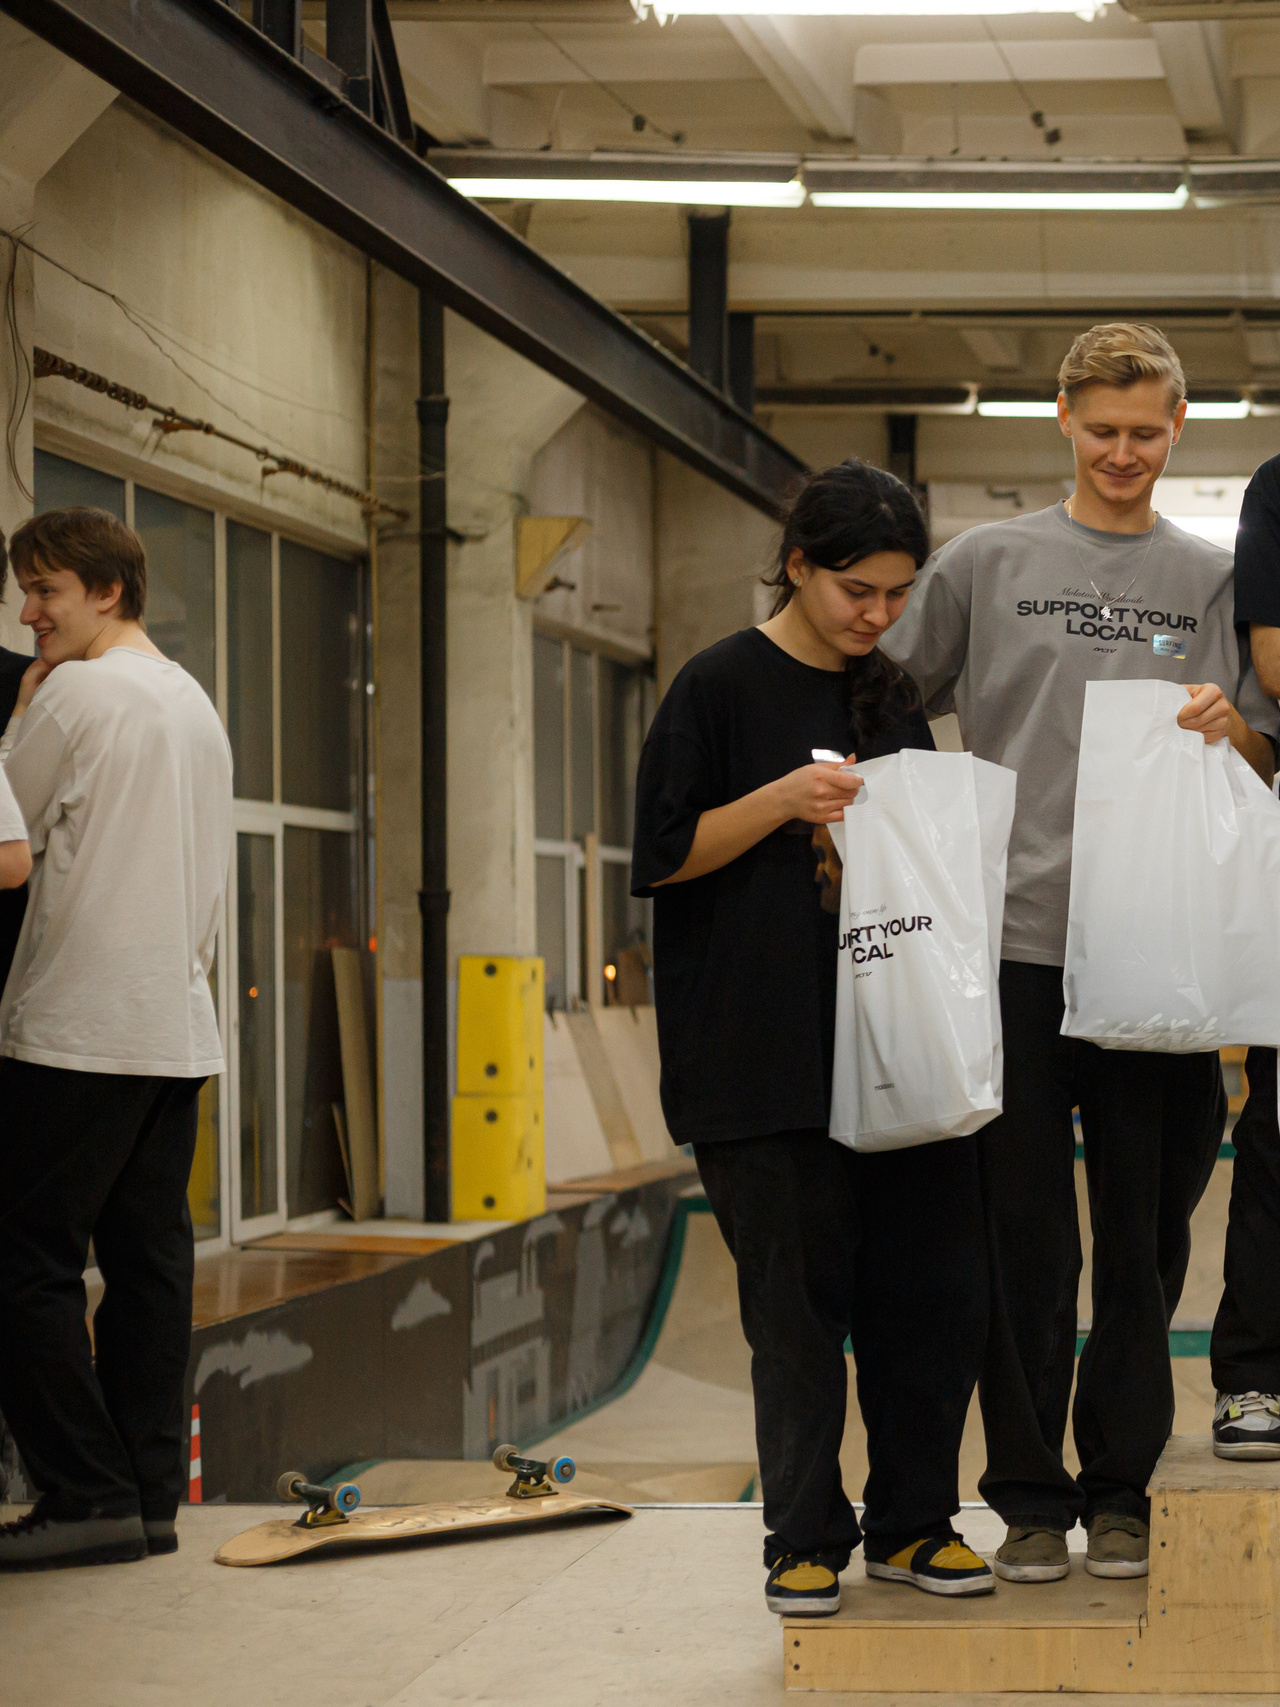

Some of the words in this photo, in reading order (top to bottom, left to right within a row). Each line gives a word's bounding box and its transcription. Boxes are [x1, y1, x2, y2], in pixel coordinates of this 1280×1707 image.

[1017, 600, 1130, 623] SUPPORT
[1132, 608, 1198, 633] YOUR
[1066, 619, 1148, 642] LOCAL
[878, 916, 933, 938] YOUR
[852, 943, 894, 964] CAL
